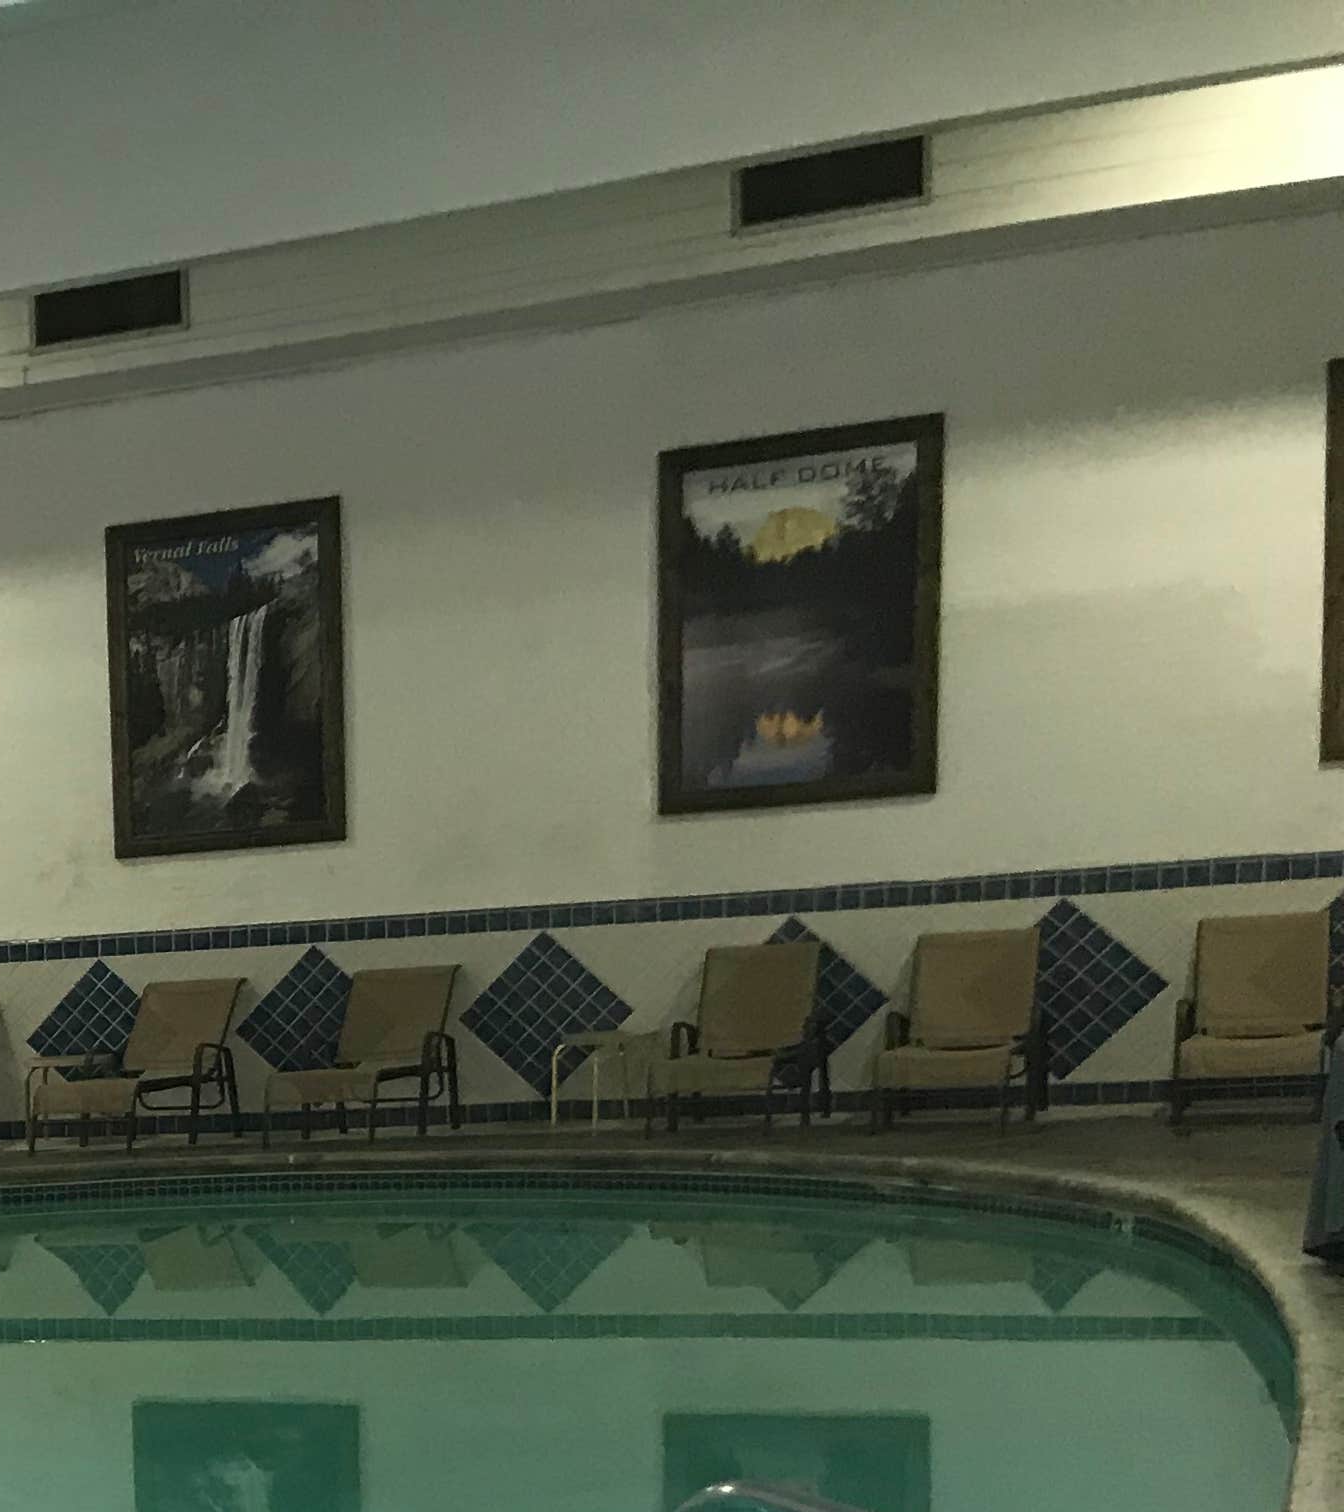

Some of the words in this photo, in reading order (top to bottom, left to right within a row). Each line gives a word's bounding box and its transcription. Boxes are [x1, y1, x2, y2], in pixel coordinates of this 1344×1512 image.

[708, 471, 785, 495] HALF
[798, 456, 889, 483] DOME
[134, 540, 192, 563] Vernal
[197, 535, 240, 556] Falls
